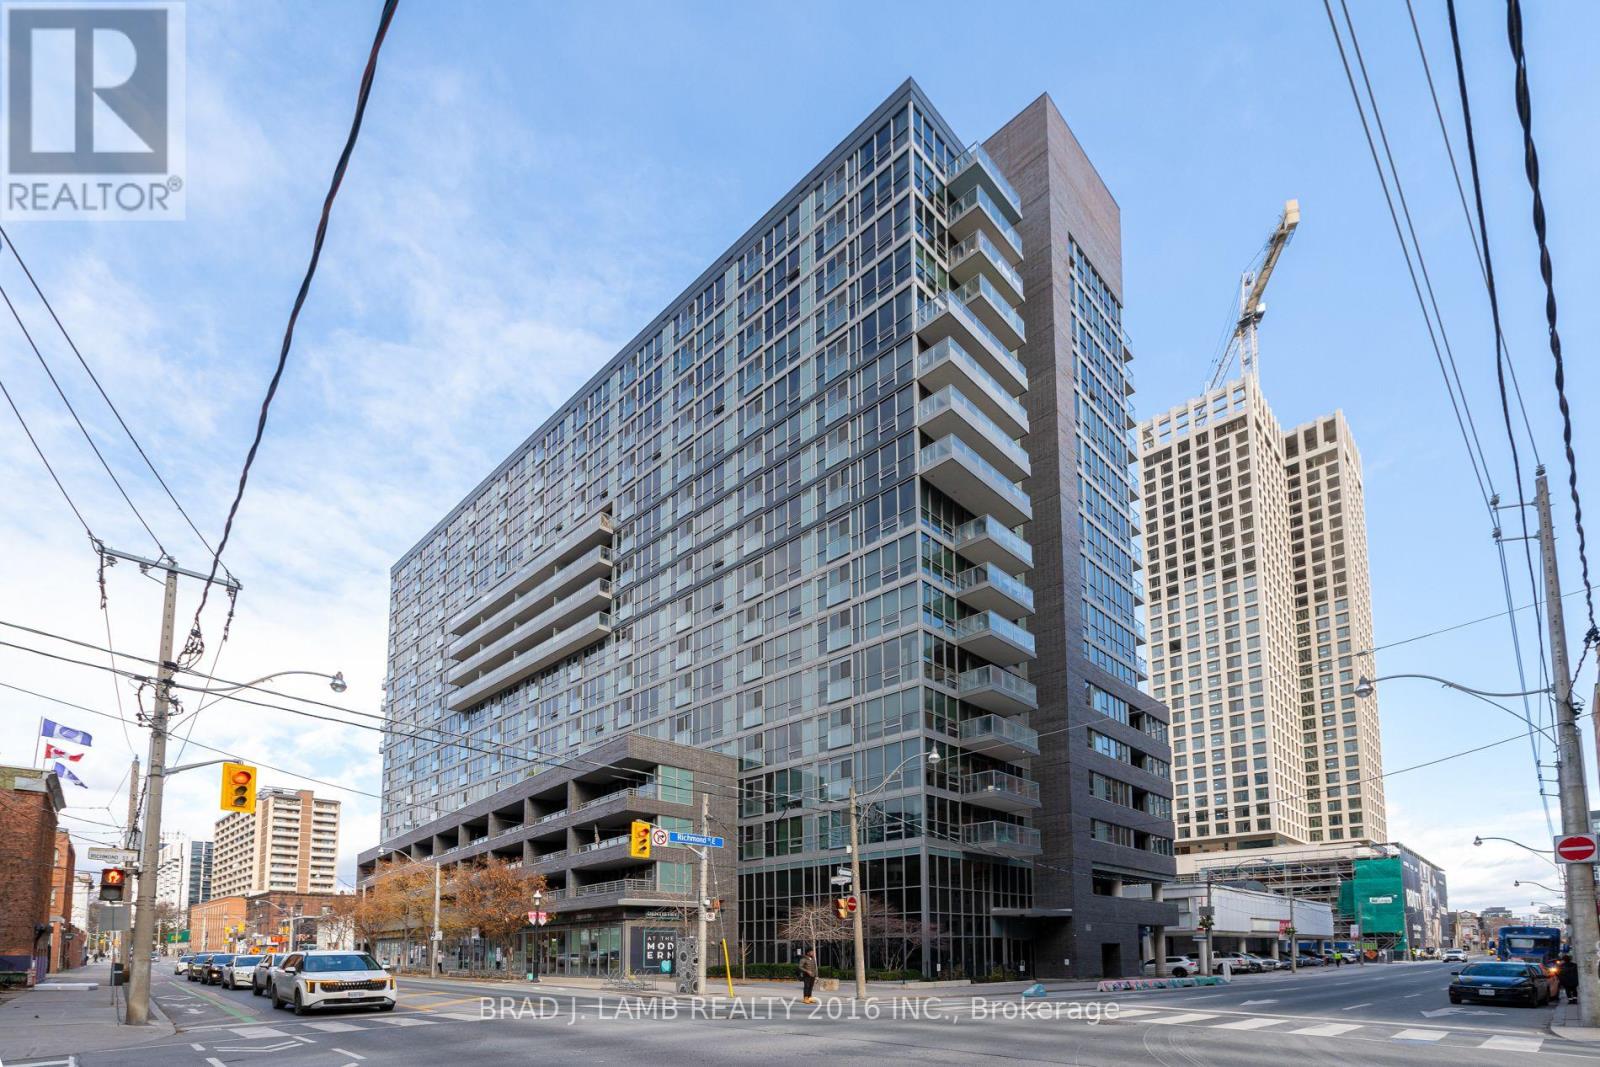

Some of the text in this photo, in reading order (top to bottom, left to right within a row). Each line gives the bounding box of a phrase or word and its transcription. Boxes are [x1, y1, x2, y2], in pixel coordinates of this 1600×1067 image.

[677, 833, 707, 844] Richmond
[647, 942, 674, 950] MOD
[647, 951, 674, 959] ERN
